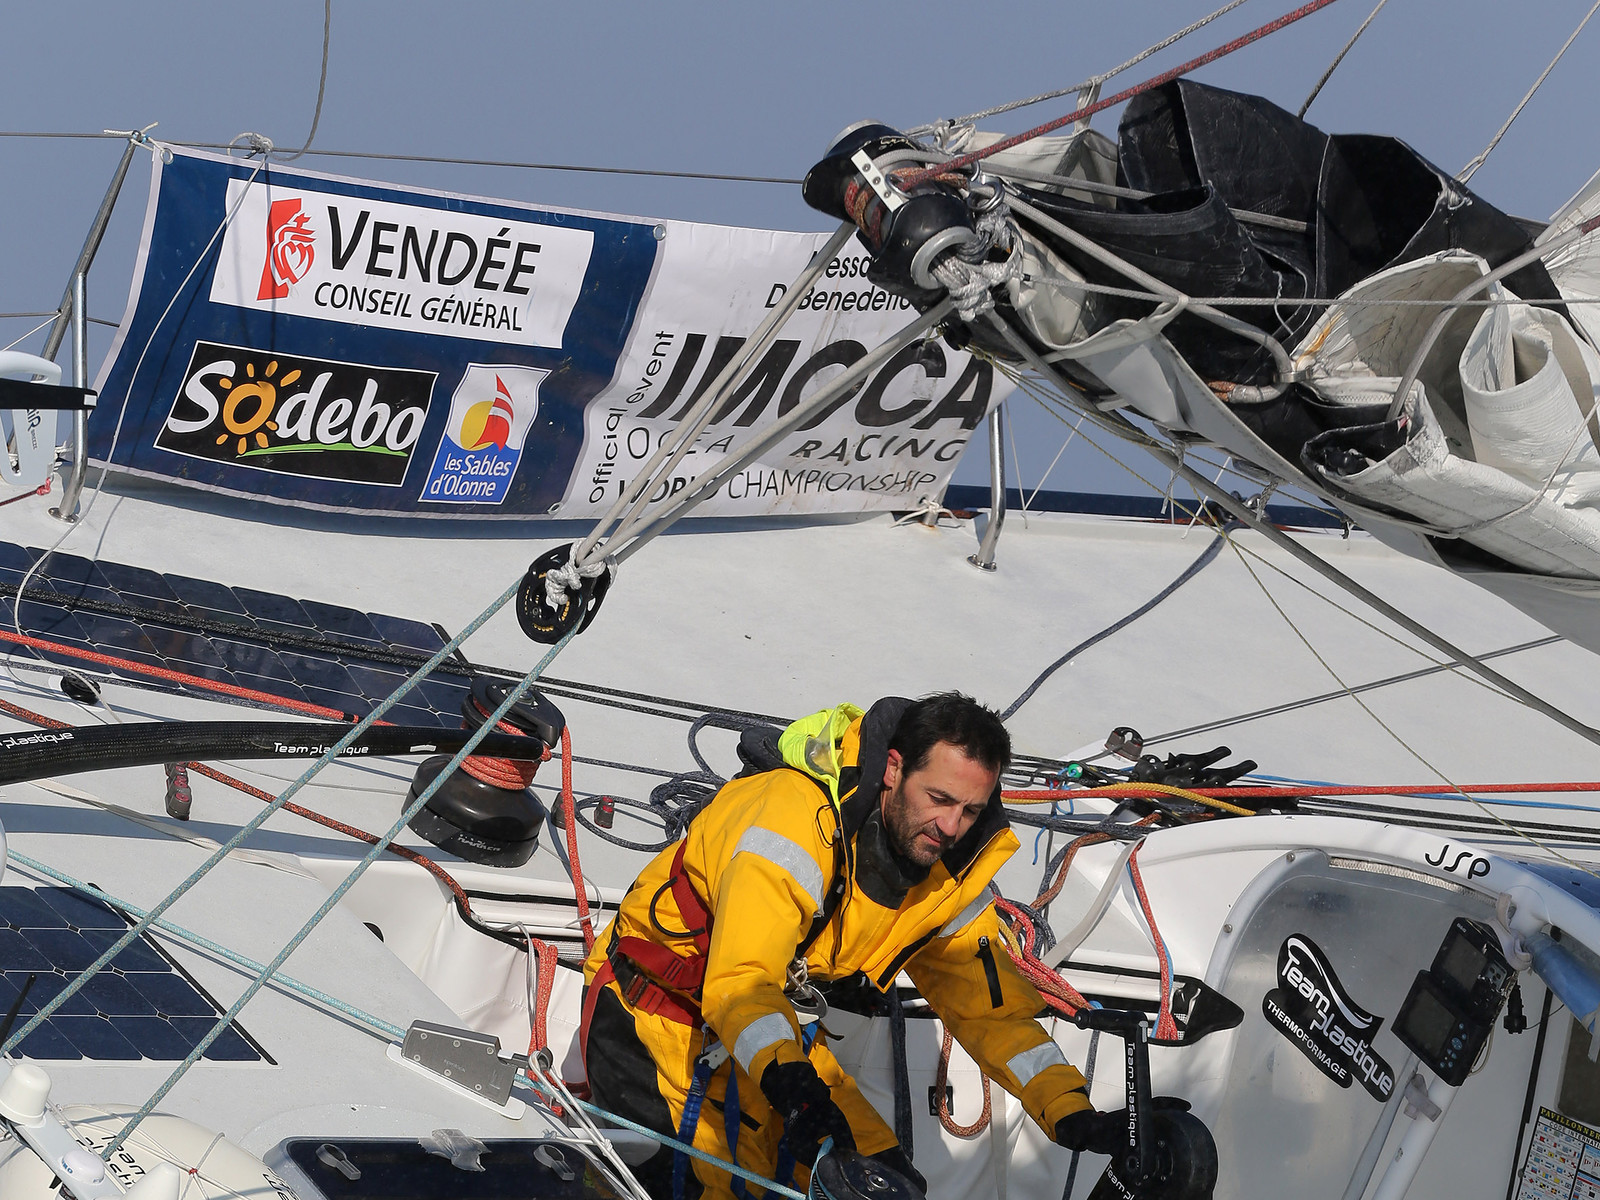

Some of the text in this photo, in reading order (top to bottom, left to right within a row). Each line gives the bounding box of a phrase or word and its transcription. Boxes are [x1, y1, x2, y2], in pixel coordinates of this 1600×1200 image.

[327, 206, 542, 295] VENDÉE
[314, 281, 523, 332] CONSEIL GÉNÉRAL
[626, 330, 675, 405] event
[635, 332, 996, 432] IMOCA
[168, 360, 428, 452] Sodebo
[444, 453, 512, 476] les Sables
[789, 433, 967, 463] RACING
[430, 473, 497, 497] d'Olonne
[728, 467, 937, 500] CHAMPIONSHIP
[3, 732, 74, 749] plastique
[274, 742, 369, 756] Team plaique
[1282, 954, 1331, 1012] Team
[1267, 999, 1348, 1080] THERMOFORMAGE
[1309, 1009, 1393, 1095] plastique
[1126, 1042, 1137, 1147] Team plastique
[1106, 1163, 1125, 1193] Team
